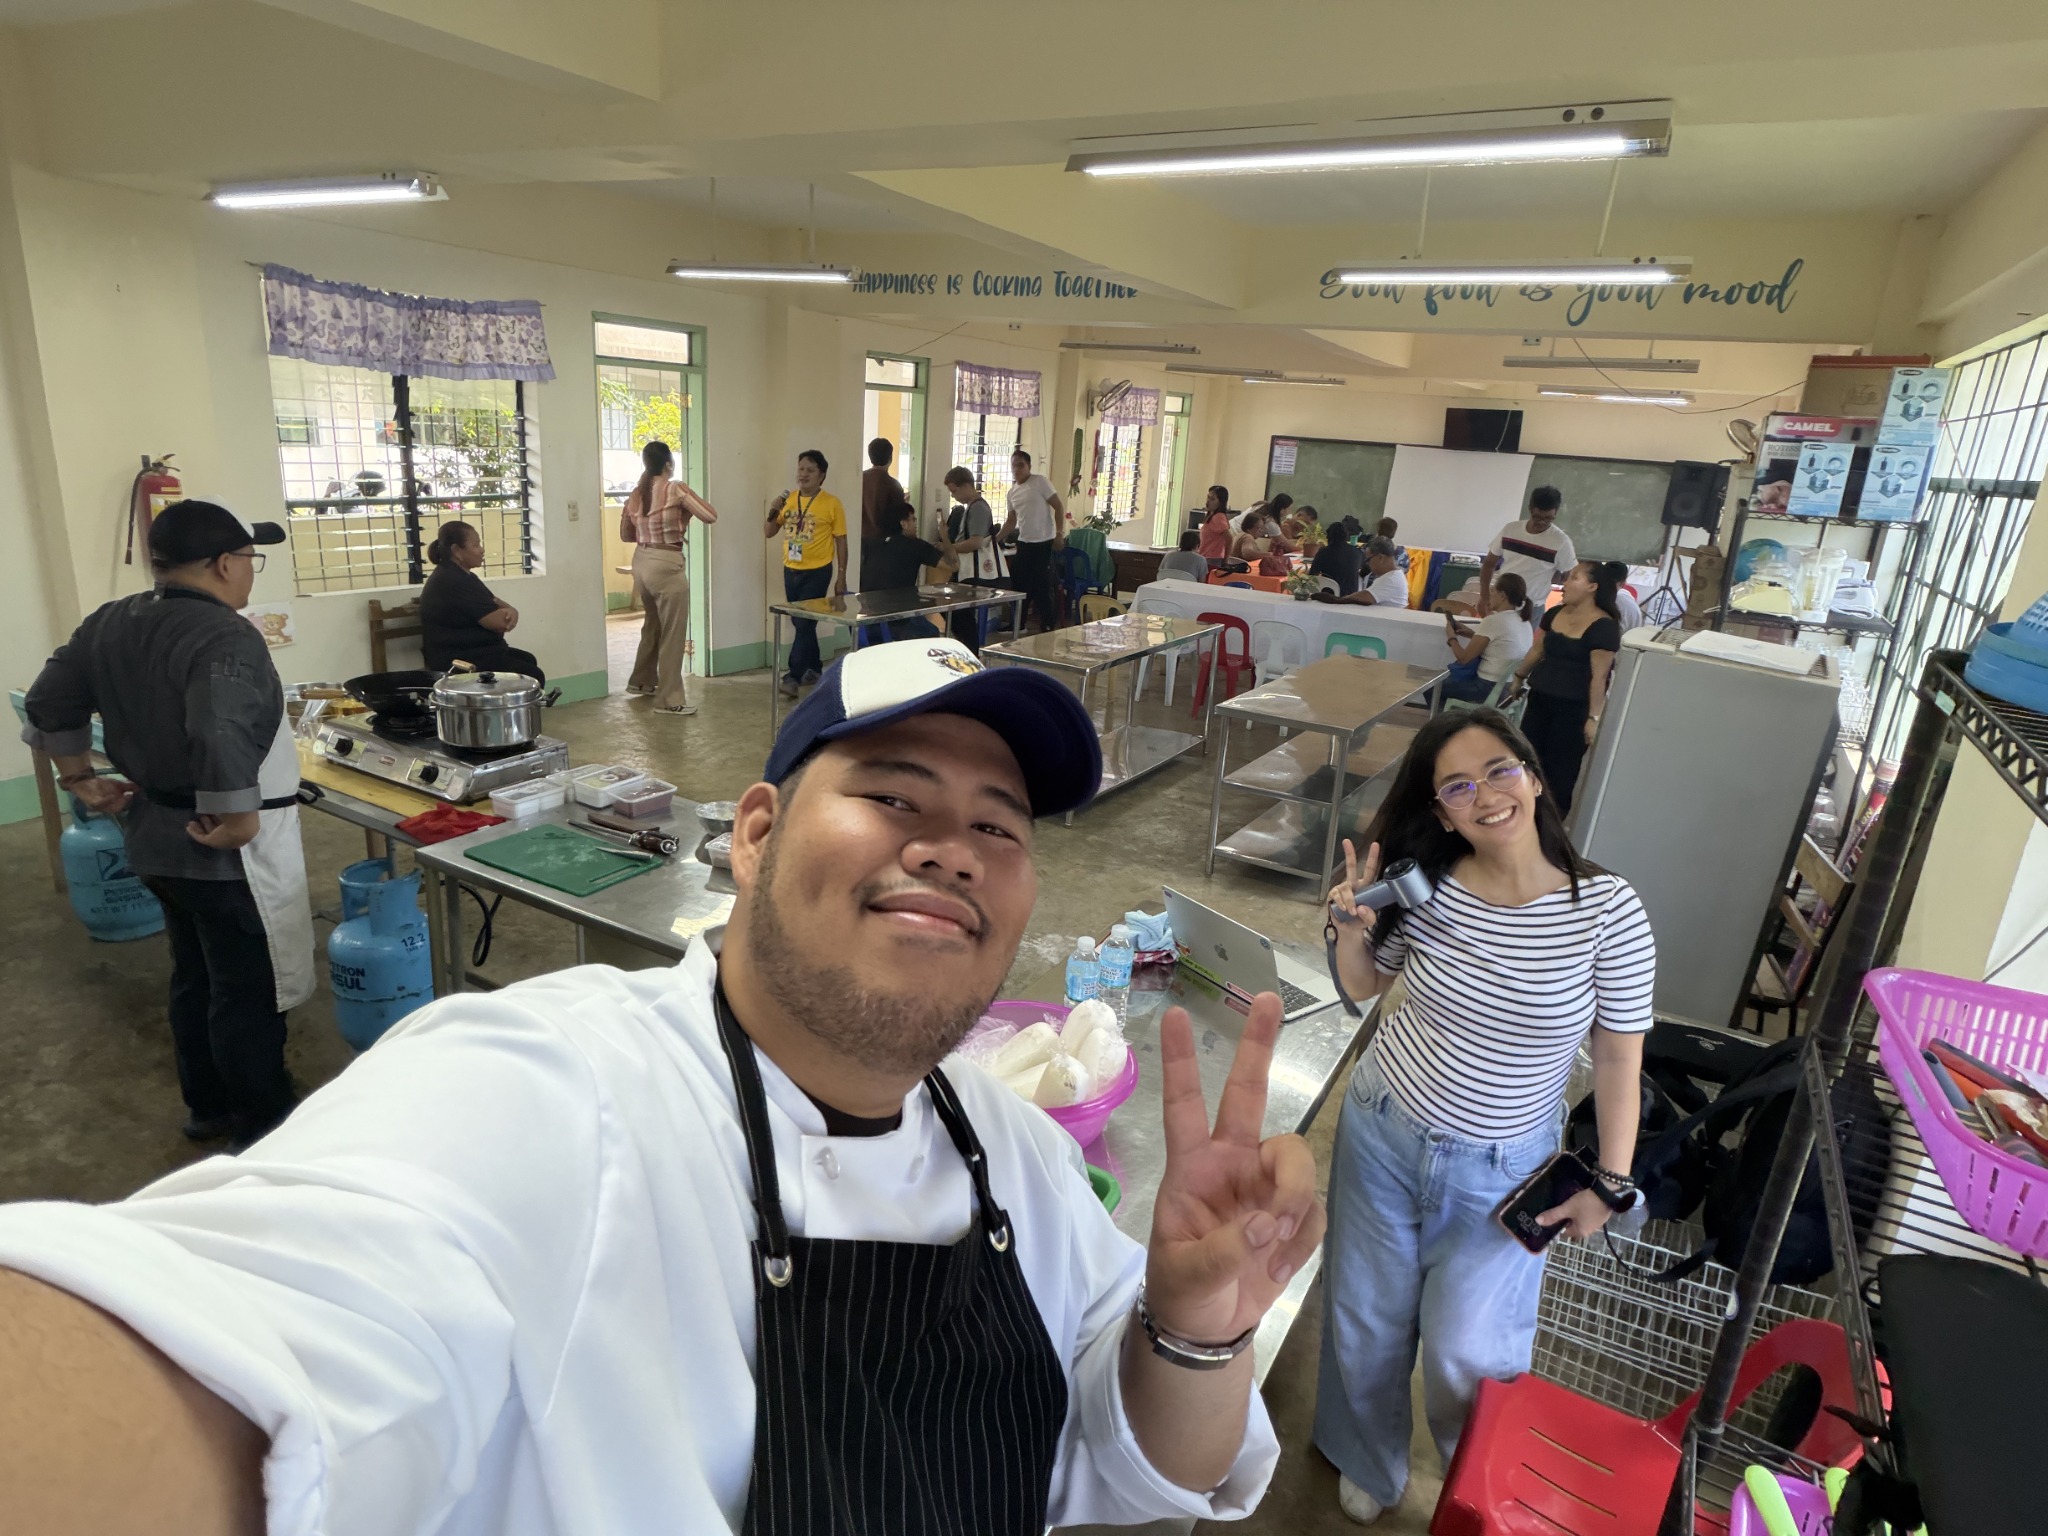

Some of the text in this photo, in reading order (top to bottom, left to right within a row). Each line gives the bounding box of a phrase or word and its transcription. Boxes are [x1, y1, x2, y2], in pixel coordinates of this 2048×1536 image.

[973, 269, 1043, 297] Cooking
[1683, 257, 1804, 314] mood
[1782, 421, 1835, 433] CAMEL
[401, 932, 427, 948] 12.2
